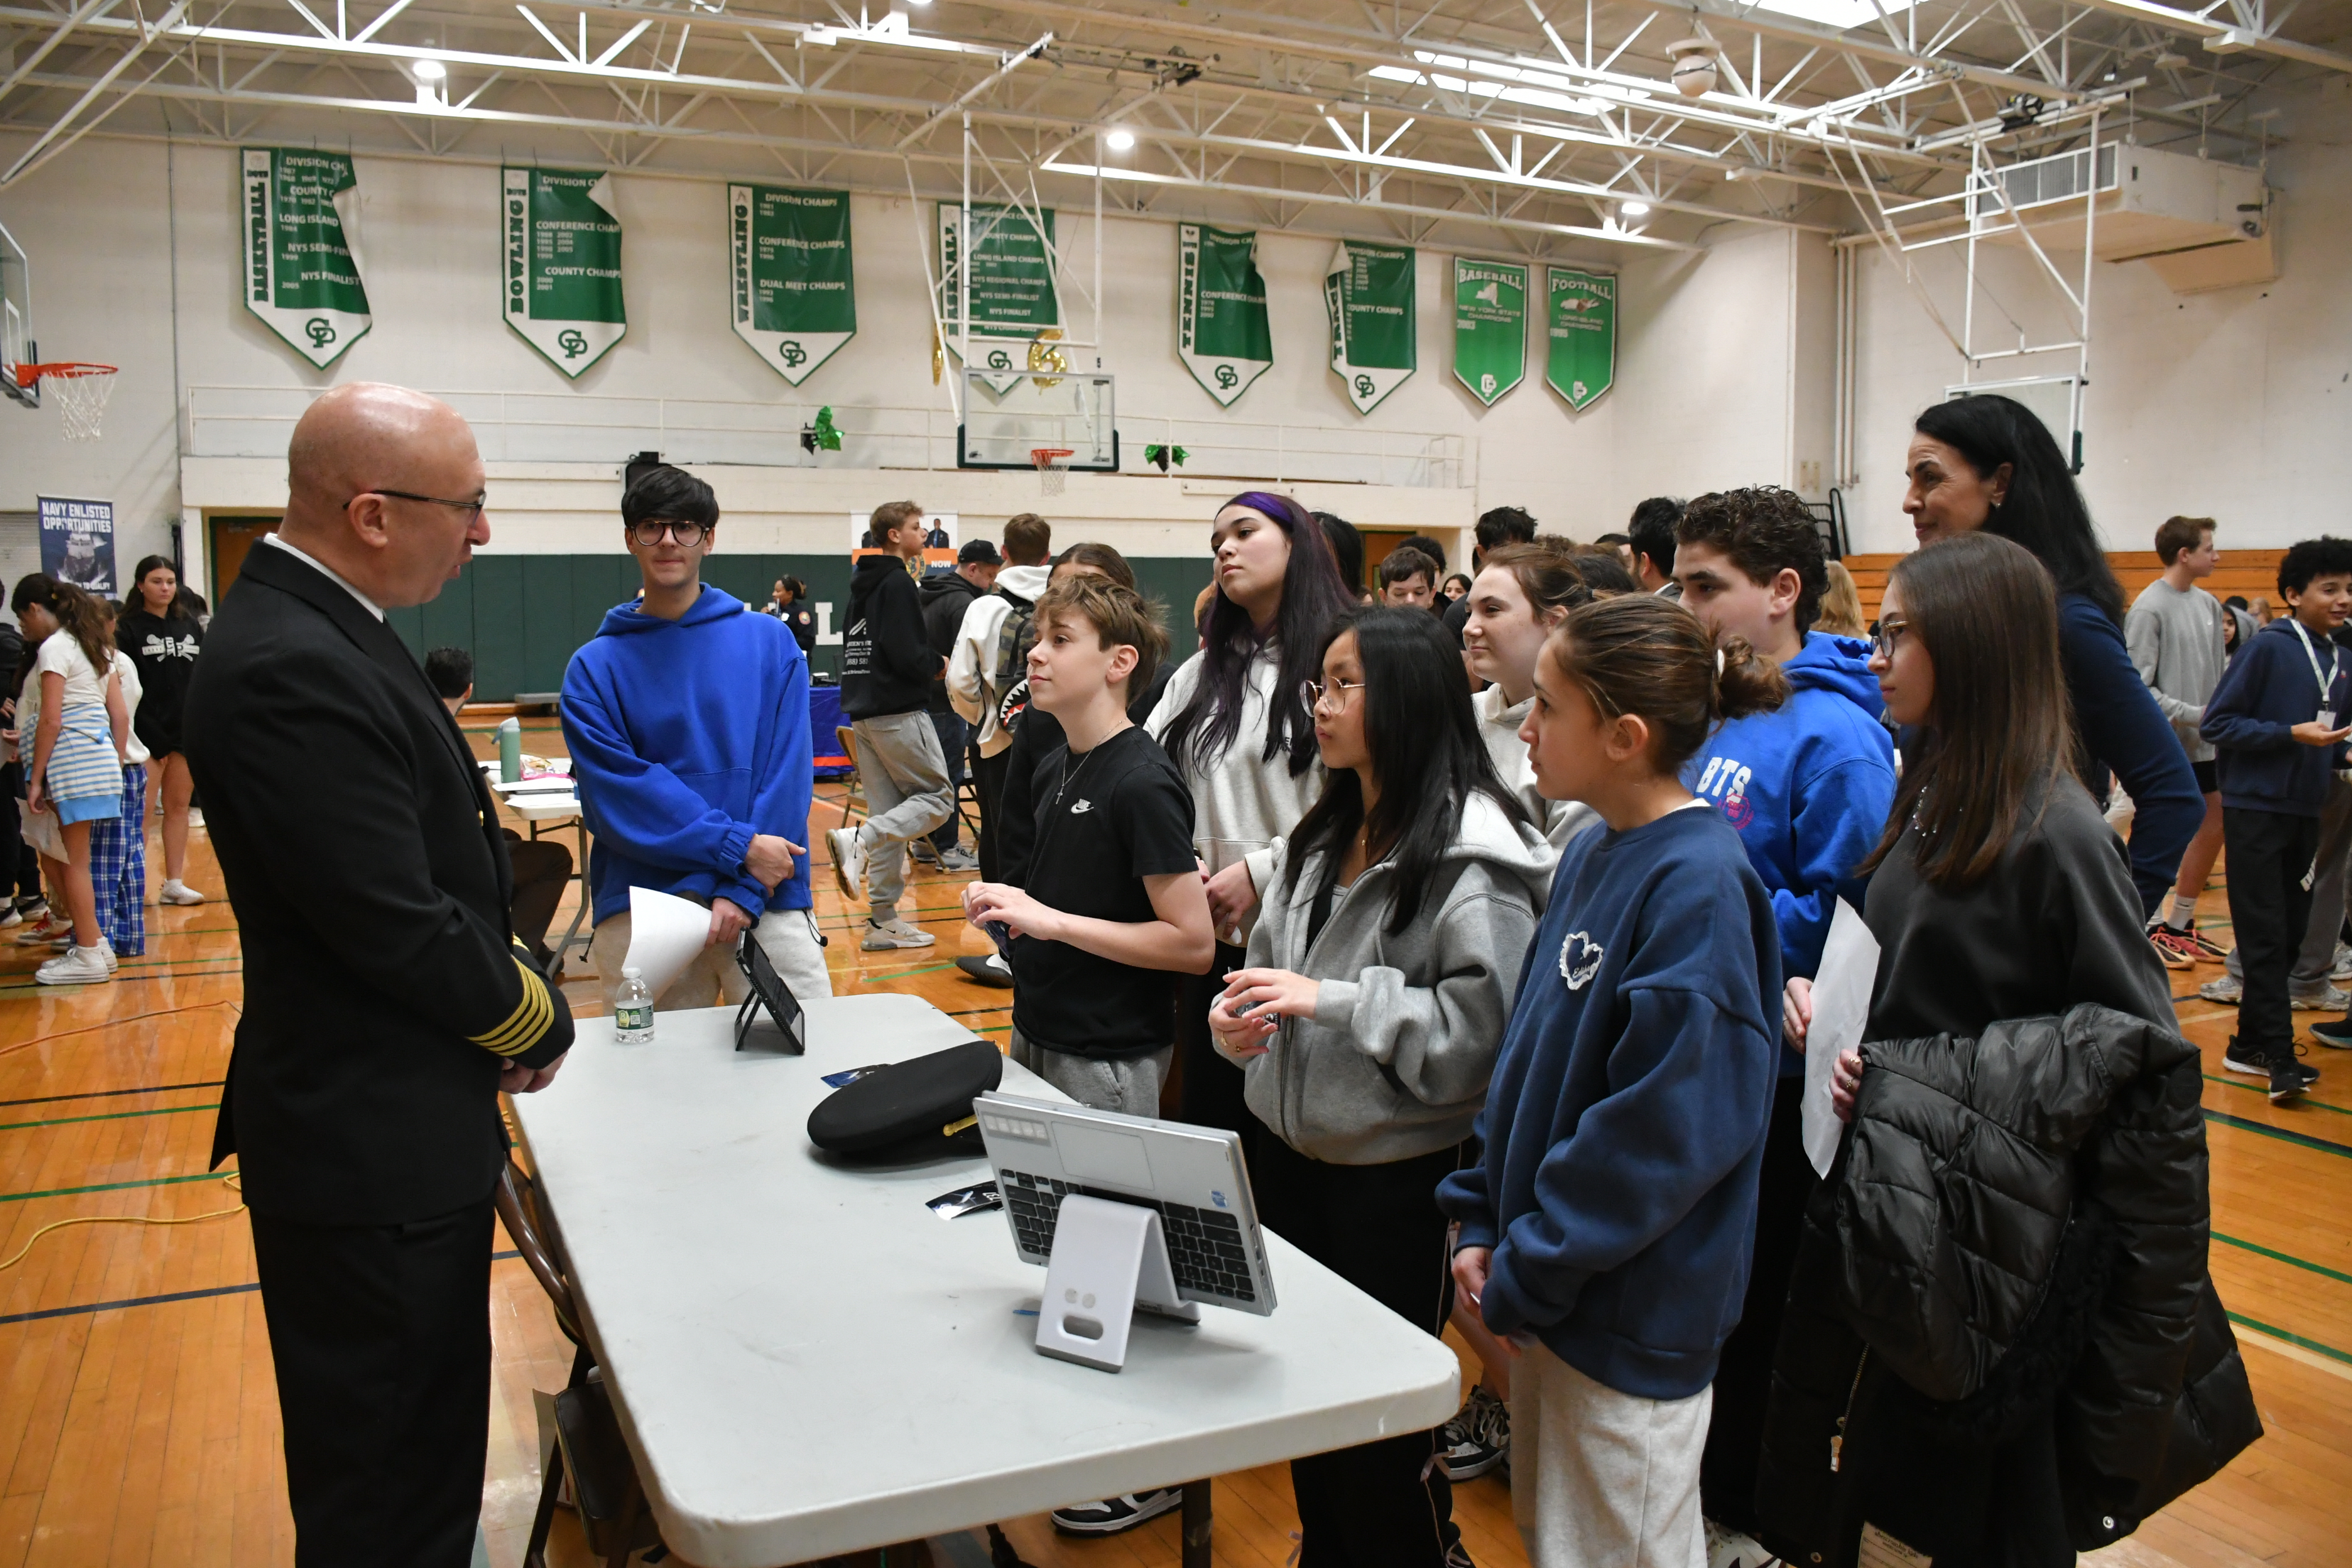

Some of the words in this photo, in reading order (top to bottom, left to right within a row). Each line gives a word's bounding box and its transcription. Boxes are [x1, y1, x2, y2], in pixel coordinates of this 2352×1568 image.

[286, 157, 329, 168] DIVISION
[542, 176, 586, 187] DIVISION
[290, 185, 327, 196] COUNTY
[279, 213, 306, 224] LONG
[307, 215, 339, 226] ISLAND
[536, 220, 595, 231] CONFERENCE
[251, 182, 268, 302] BASKETBALL
[810, 240, 845, 250] CHAMPS
[287, 242, 308, 252] NYS
[309, 242, 351, 256] SEMI-FIN
[510, 199, 524, 314] BOWLING
[301, 271, 321, 281] NYS
[545, 266, 585, 276] COUNTY
[760, 278, 785, 289] DUAL
[809, 282, 846, 290] CHAMPS
[1459, 269, 1523, 291] BASEBALL
[1552, 278, 1612, 300] FOOTBALL
[1182, 252, 1195, 349] TENNIS
[1201, 290, 1247, 302] CONFERENCE
[42, 501, 67, 516] NAVY
[68, 502, 111, 519] ENLISTED
[931, 560, 952, 568] NOW
[1696, 757, 1752, 804] BTS
[1874, 1531, 1906, 1552] abercrombie
